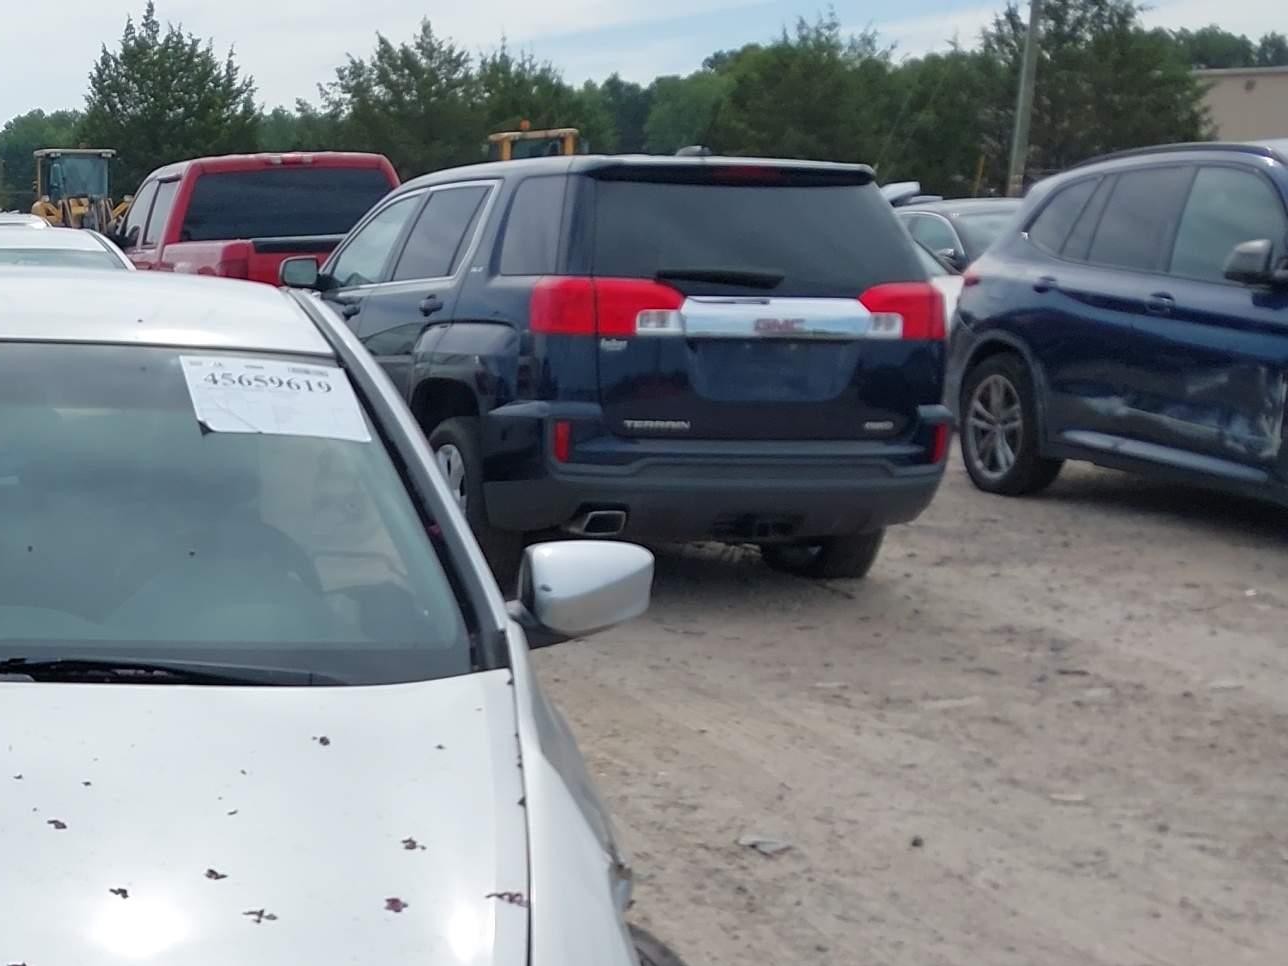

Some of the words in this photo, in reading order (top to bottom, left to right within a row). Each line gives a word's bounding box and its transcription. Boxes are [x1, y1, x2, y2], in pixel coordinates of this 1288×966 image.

[753, 318, 806, 332] GMC
[203, 371, 333, 394] 45659619
[623, 419, 691, 431] TERRAIN
